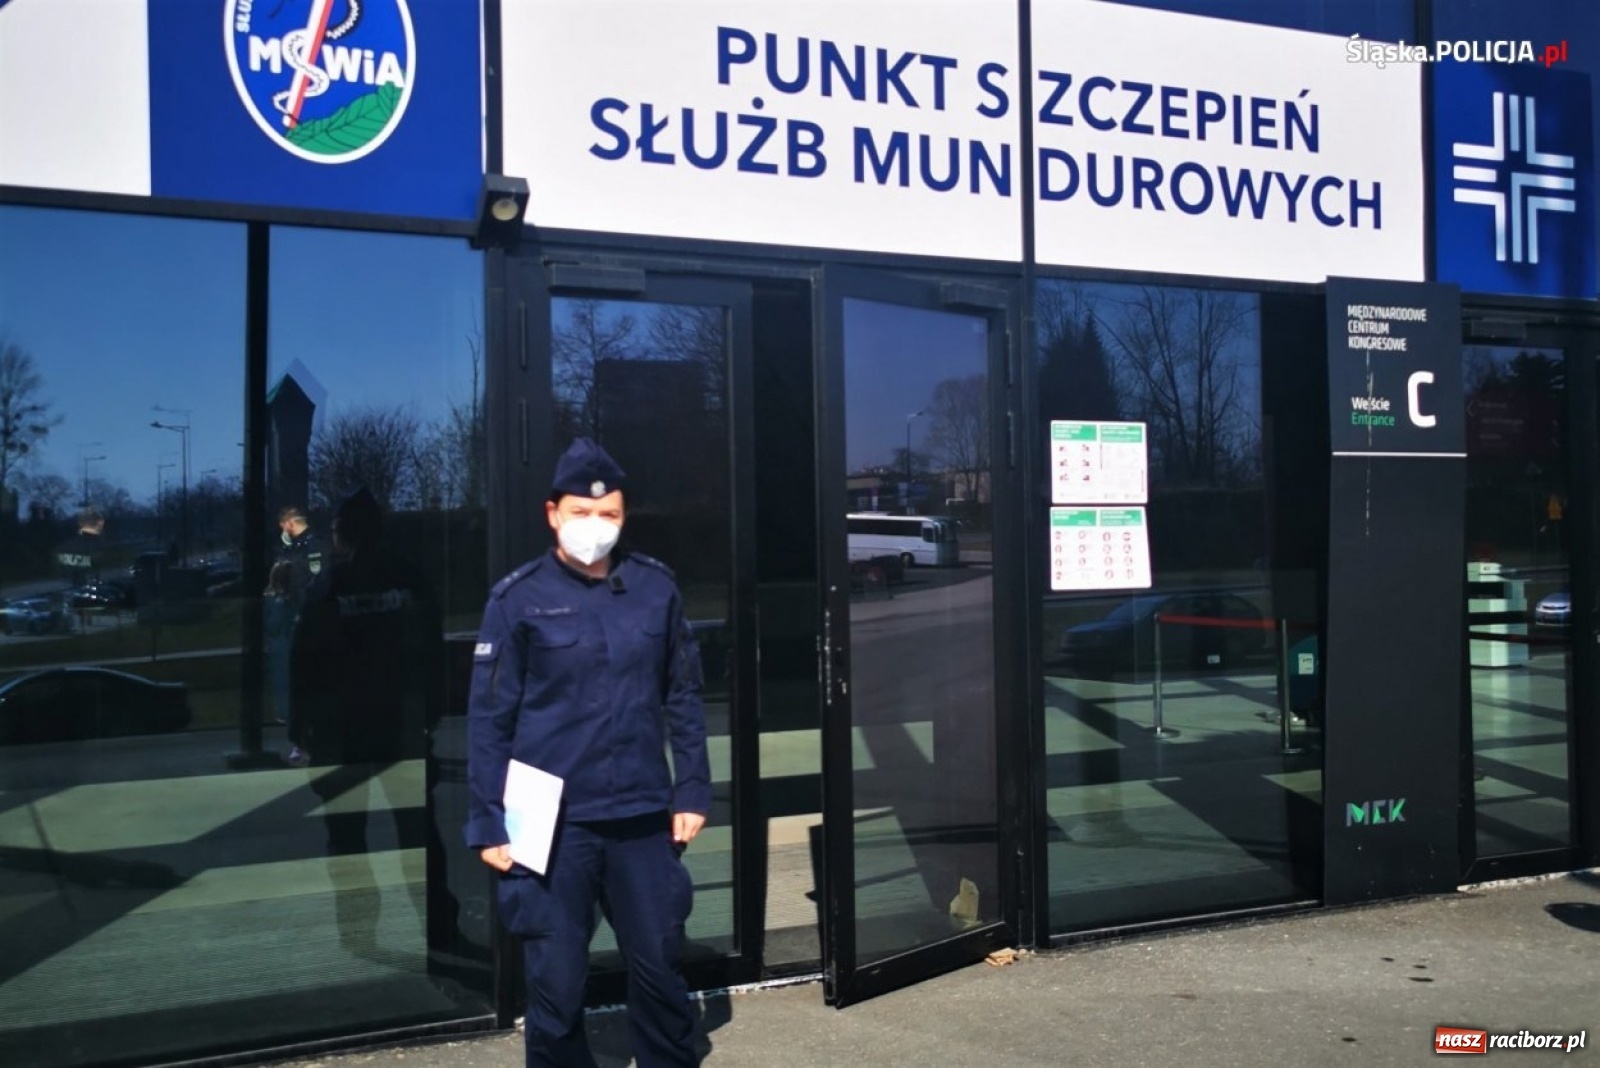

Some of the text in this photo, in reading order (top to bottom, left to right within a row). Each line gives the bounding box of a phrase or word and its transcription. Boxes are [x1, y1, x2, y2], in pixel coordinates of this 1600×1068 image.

[717, 26, 957, 111] PUNKT
[589, 96, 828, 178] SŁUŻB
[1347, 304, 1427, 322] MIĘDZYNARODOWE
[1347, 320, 1390, 334] CENTRUM
[1348, 336, 1407, 351] KONGRESOWE
[1407, 370, 1437, 428] C
[1351, 412, 1395, 426] Entrance
